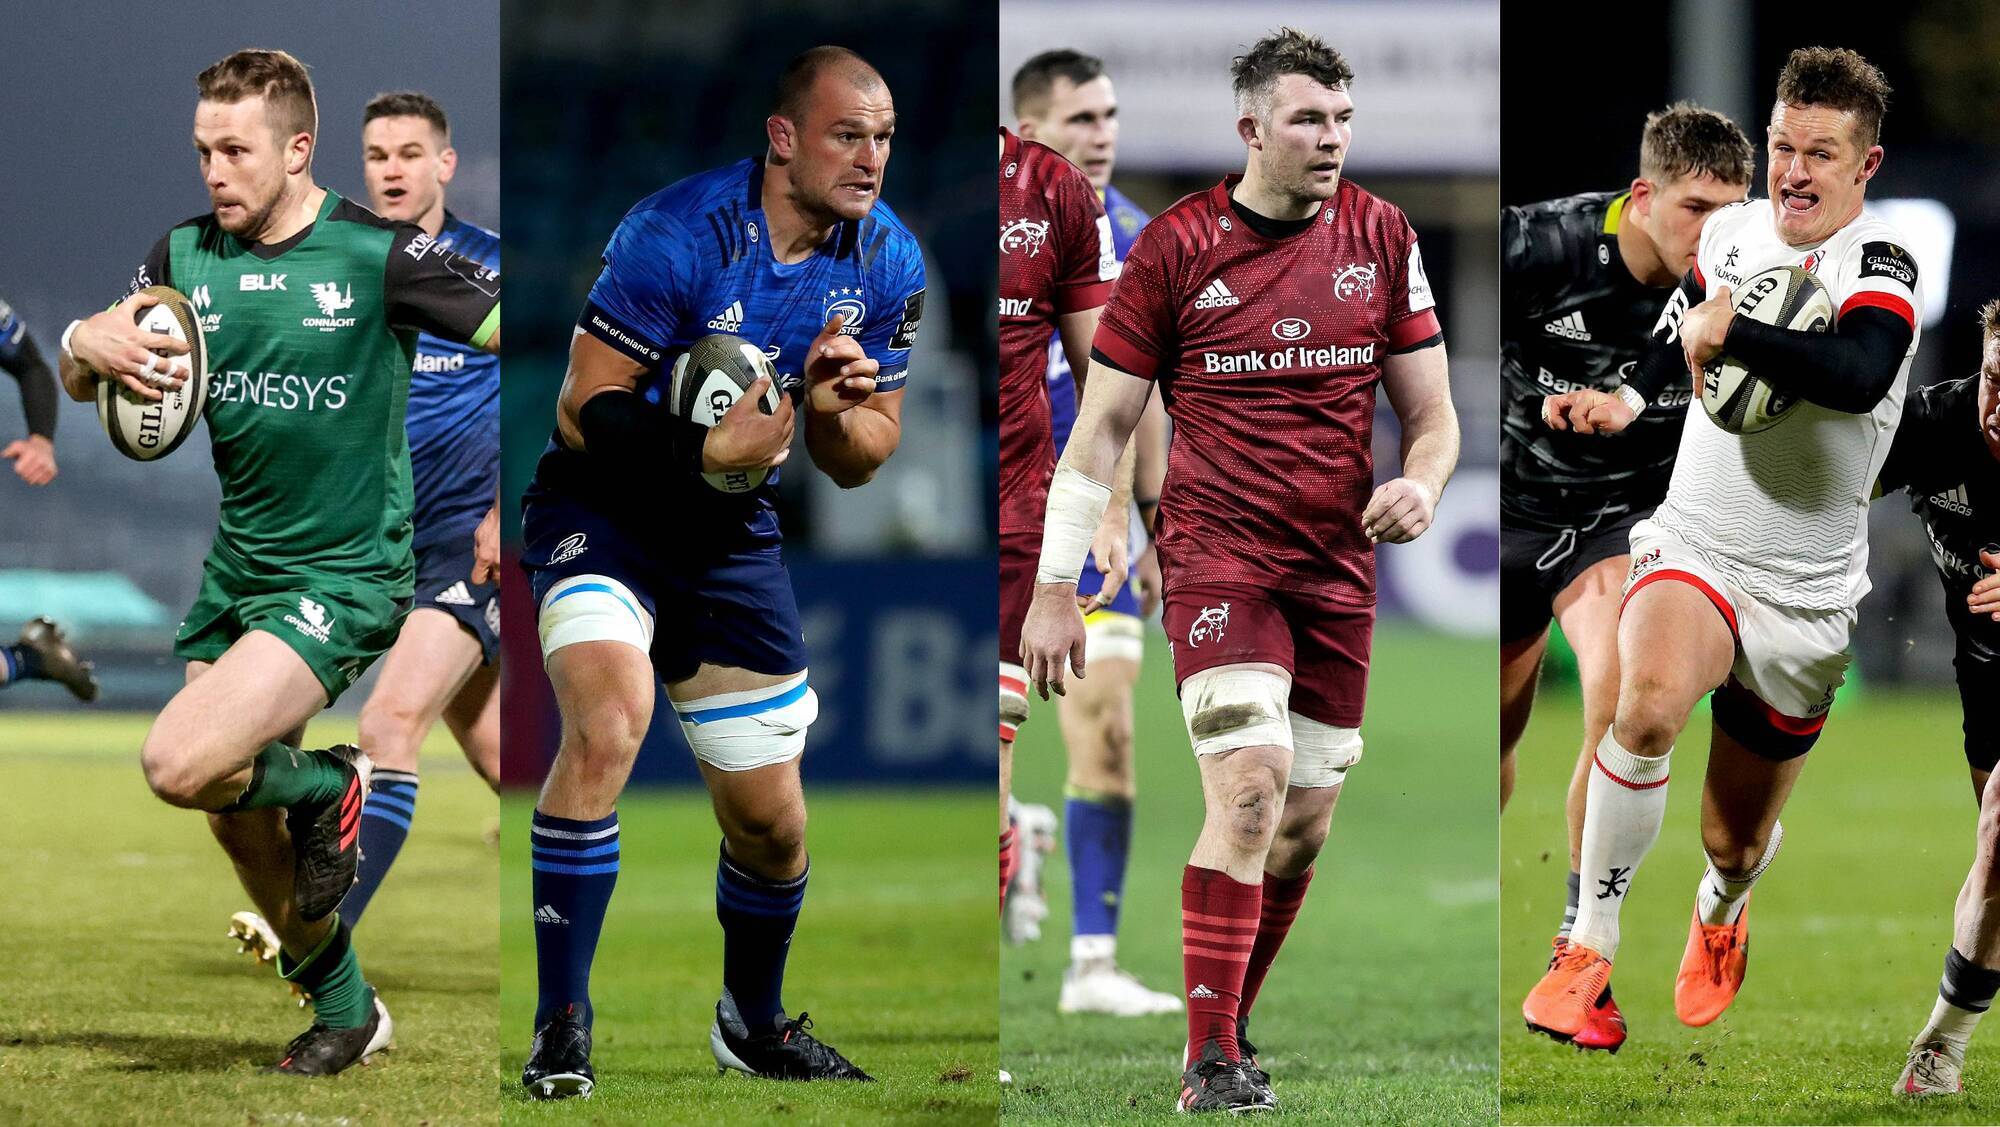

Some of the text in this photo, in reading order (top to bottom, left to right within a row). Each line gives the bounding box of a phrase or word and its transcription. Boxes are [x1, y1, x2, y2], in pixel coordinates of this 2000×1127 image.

[240, 274, 288, 291] BLK
[1715, 264, 1743, 286] KUKRI
[1195, 295, 1240, 310] adidas
[303, 318, 356, 327] CONNACHT
[1544, 322, 1592, 341] adidas
[592, 315, 650, 355] Bank of Ireland
[1204, 343, 1375, 373] Bank of Ireland
[207, 371, 347, 411] GENESYS
[1929, 495, 1973, 517] adidas
[284, 614, 329, 644] CONNACHT
